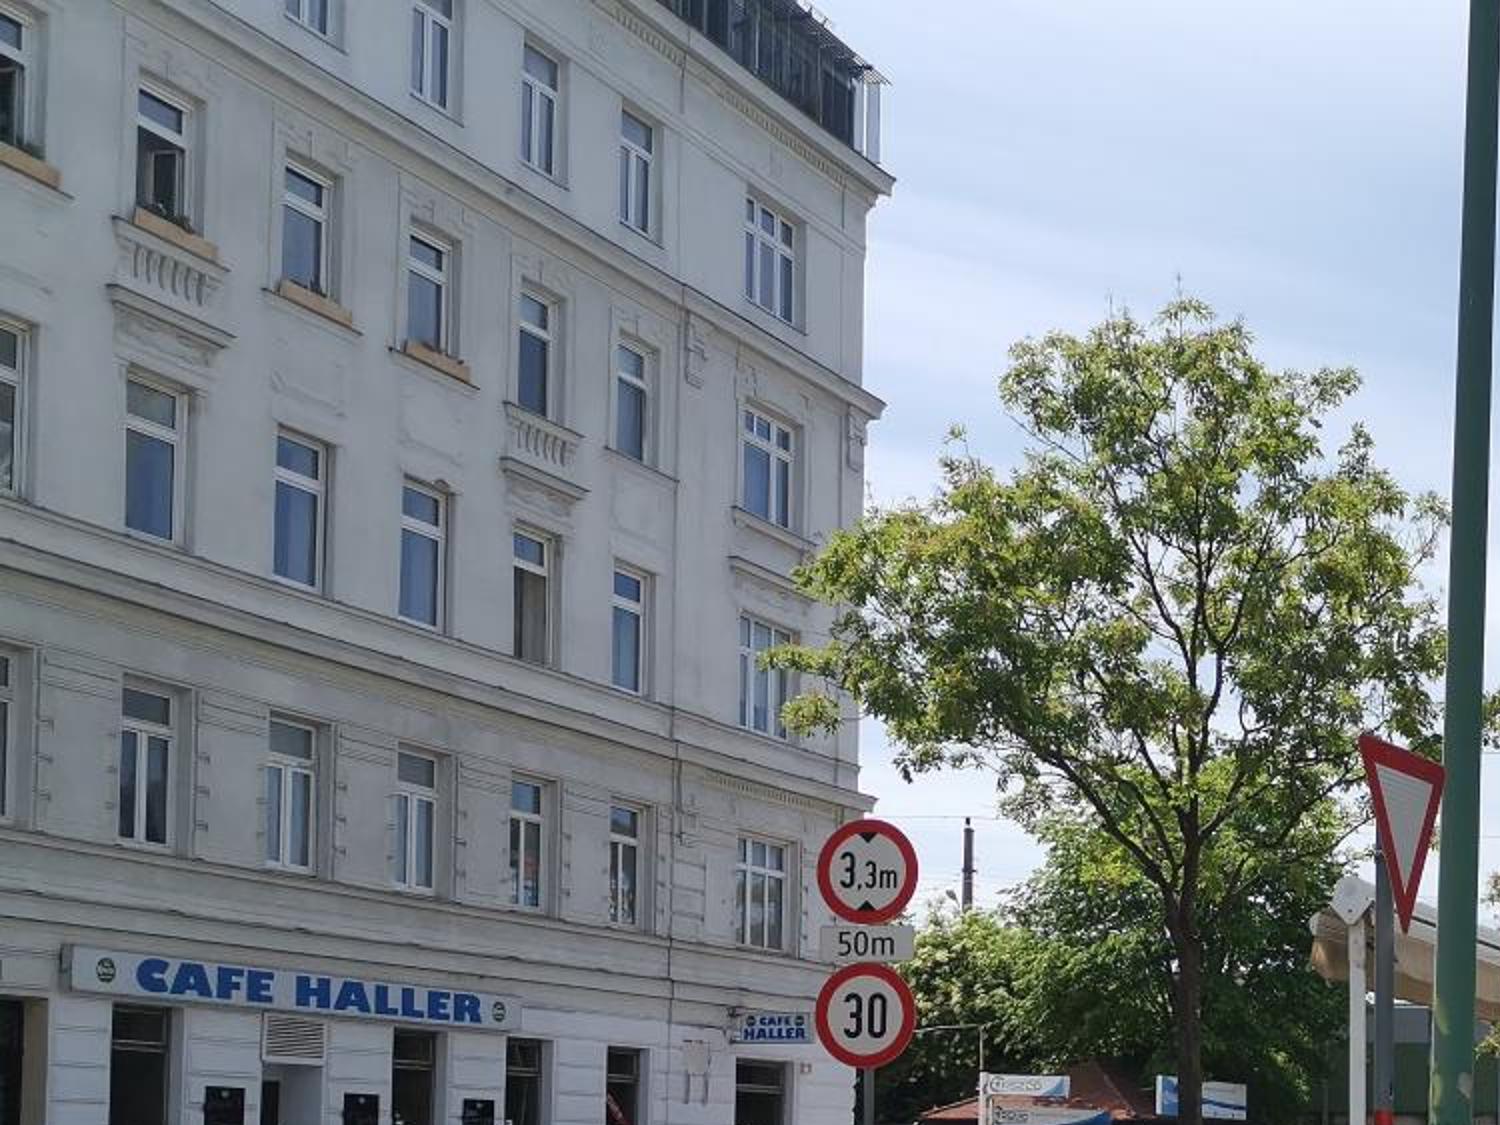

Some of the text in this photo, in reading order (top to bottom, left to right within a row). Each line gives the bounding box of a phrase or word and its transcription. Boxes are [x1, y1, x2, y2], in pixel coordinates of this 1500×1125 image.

[840, 851, 897, 892] 3,3m
[838, 932, 894, 957] 50m
[136, 957, 275, 1003] CAFE
[296, 975, 482, 1024] HALLER
[759, 1015, 791, 1026] CAFE
[844, 993, 888, 1039] 30
[744, 1028, 805, 1040] HALLER
